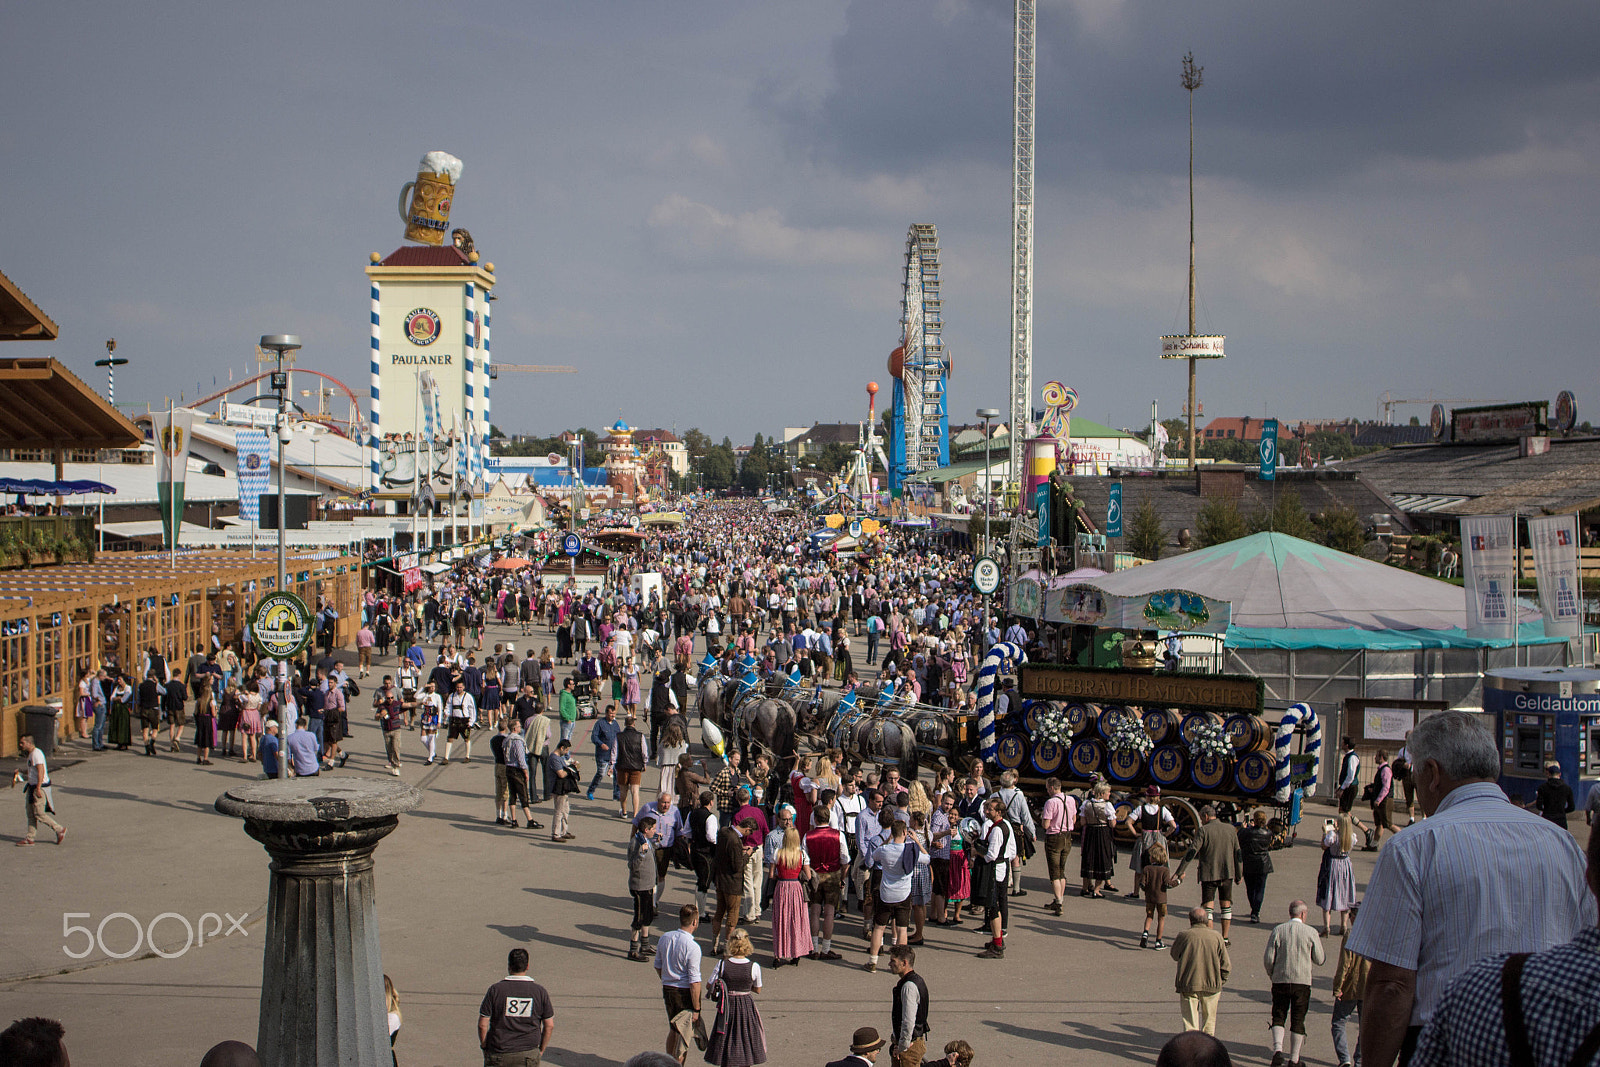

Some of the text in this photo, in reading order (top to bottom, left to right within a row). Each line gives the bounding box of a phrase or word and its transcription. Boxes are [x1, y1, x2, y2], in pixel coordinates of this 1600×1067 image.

[392, 354, 452, 365] PAULANER
[1478, 572, 1506, 581] girocard
[258, 632, 290, 640] Münchner
[1514, 694, 1600, 712] Geldautom
[508, 1000, 531, 1016] 87
